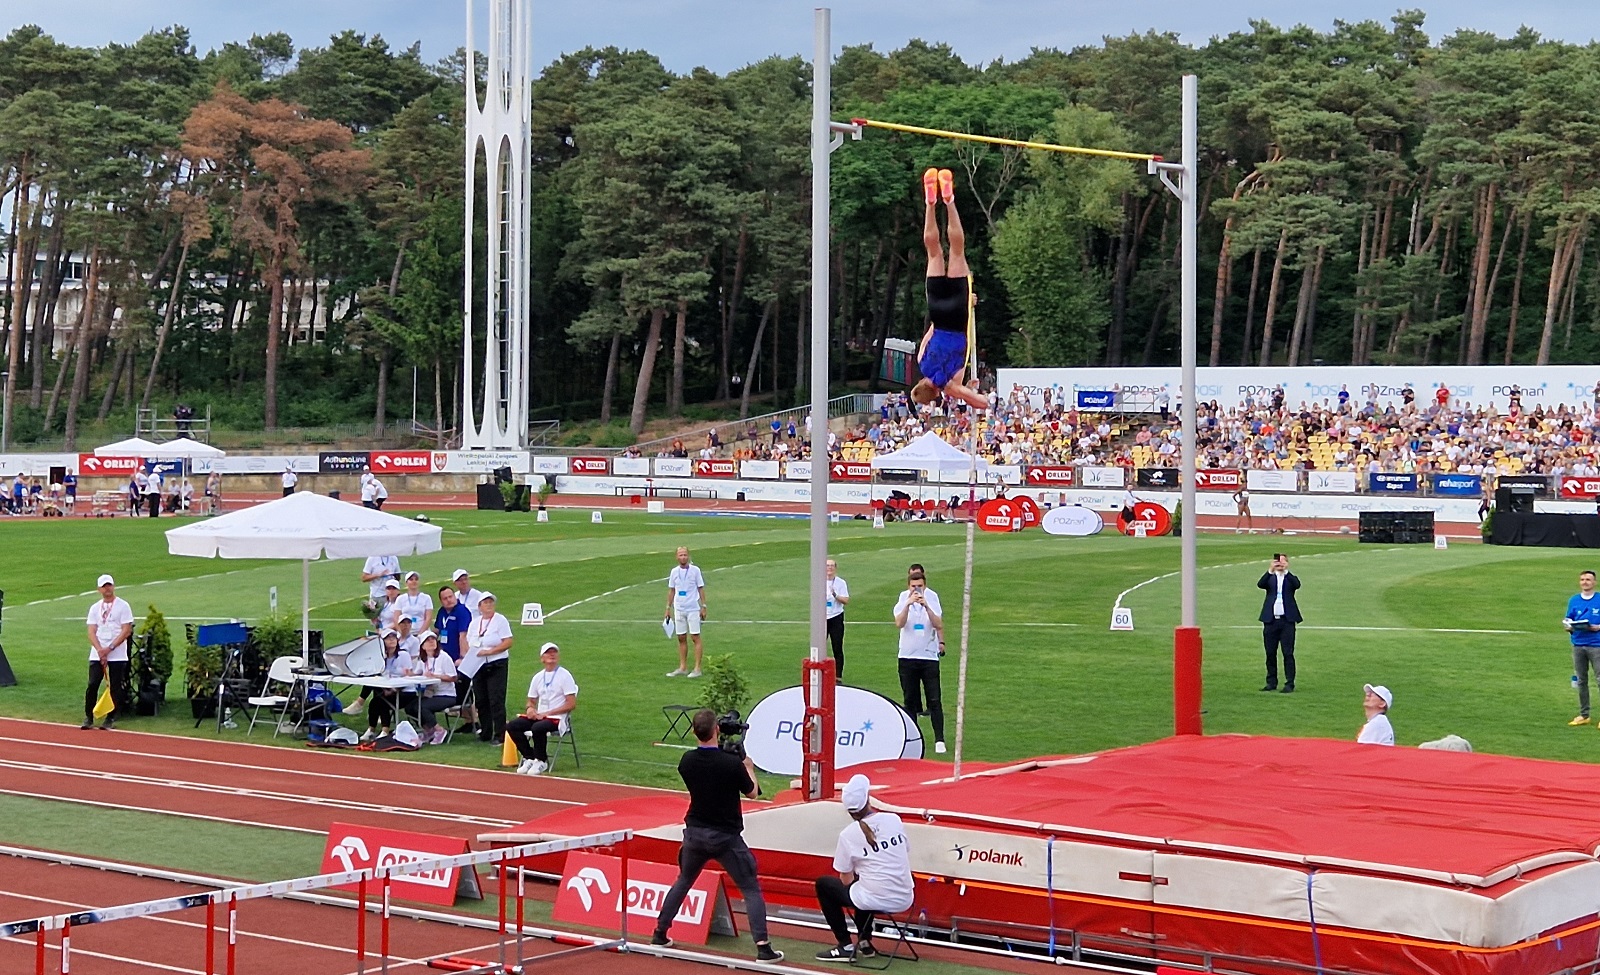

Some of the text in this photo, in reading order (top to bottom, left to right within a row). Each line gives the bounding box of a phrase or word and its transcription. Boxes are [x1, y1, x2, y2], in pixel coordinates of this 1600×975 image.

[103, 459, 139, 469] ORLEN
[393, 457, 427, 467] ORLEN
[526, 609, 539, 619] 70
[1115, 614, 1129, 624] 60
[968, 848, 1024, 867] polanik
